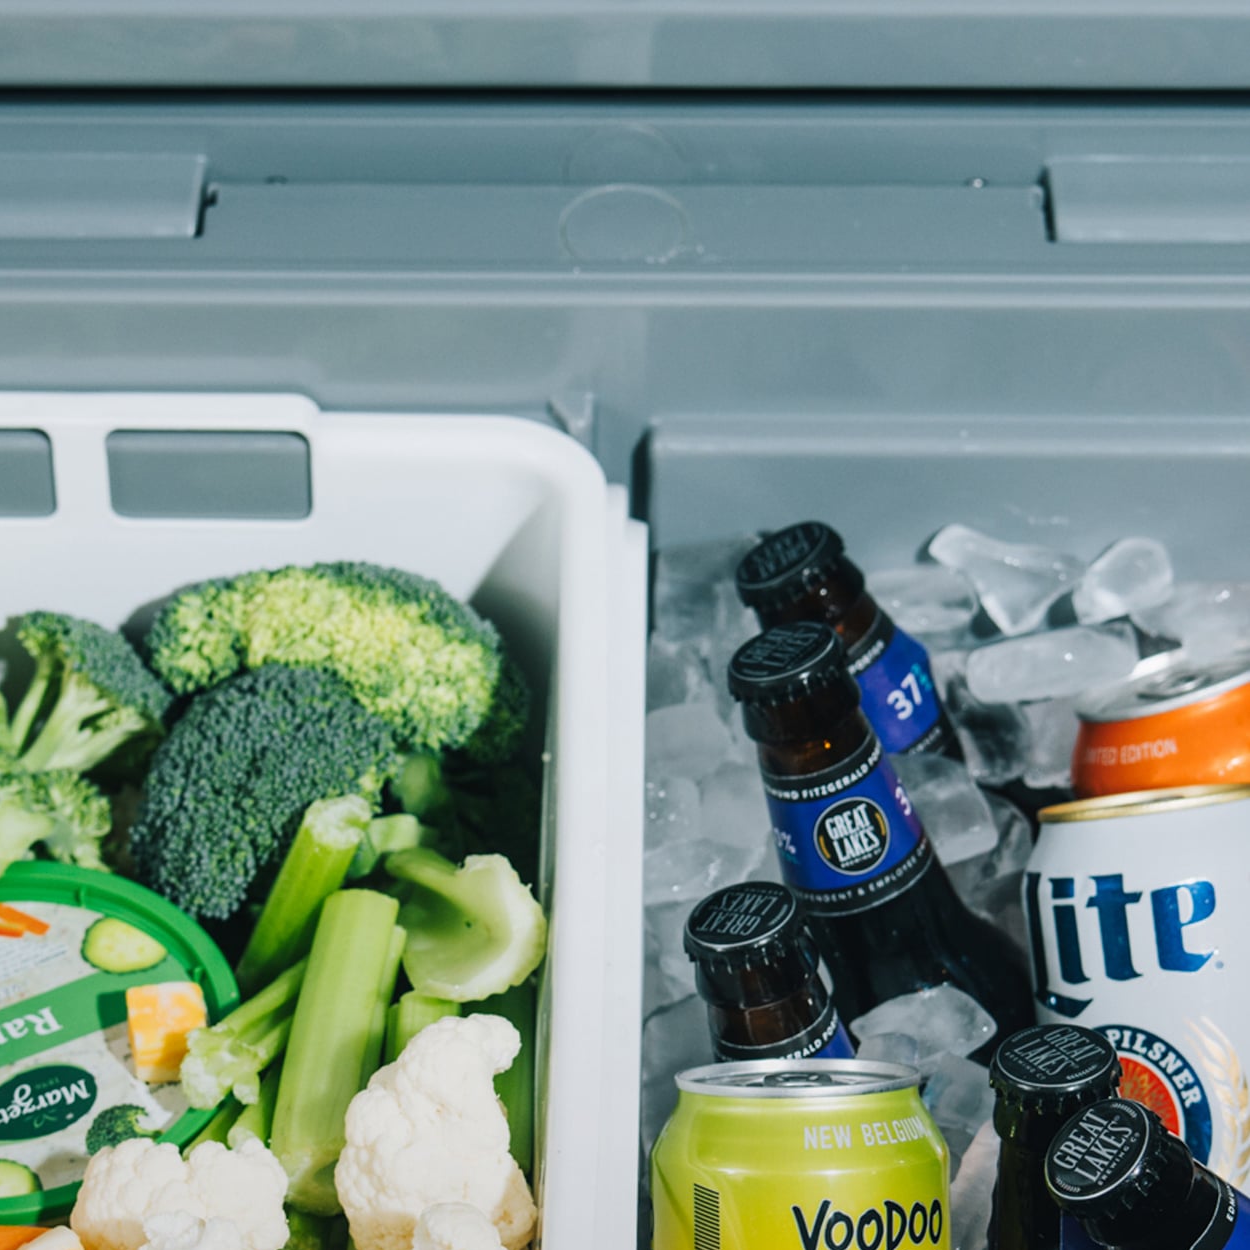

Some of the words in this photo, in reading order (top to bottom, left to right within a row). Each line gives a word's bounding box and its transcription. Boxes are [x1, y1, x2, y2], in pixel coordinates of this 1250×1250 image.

[887, 672, 922, 720] 37
[1120, 738, 1179, 765] EDITION
[802, 763, 868, 799] FITZGERALD
[824, 803, 870, 840] GREAT
[833, 828, 881, 863] LAKES
[720, 892, 779, 915] LAKES
[696, 911, 761, 936] GREAT
[1024, 871, 1216, 1019] Lite
[1014, 1038, 1076, 1076] LAKES
[1043, 1027, 1106, 1062] GREAT
[1105, 1030, 1202, 1109] PILSNER
[803, 1124, 852, 1150] NEW
[1053, 1108, 1109, 1169] GREAT
[1074, 1120, 1132, 1182] LAKES
